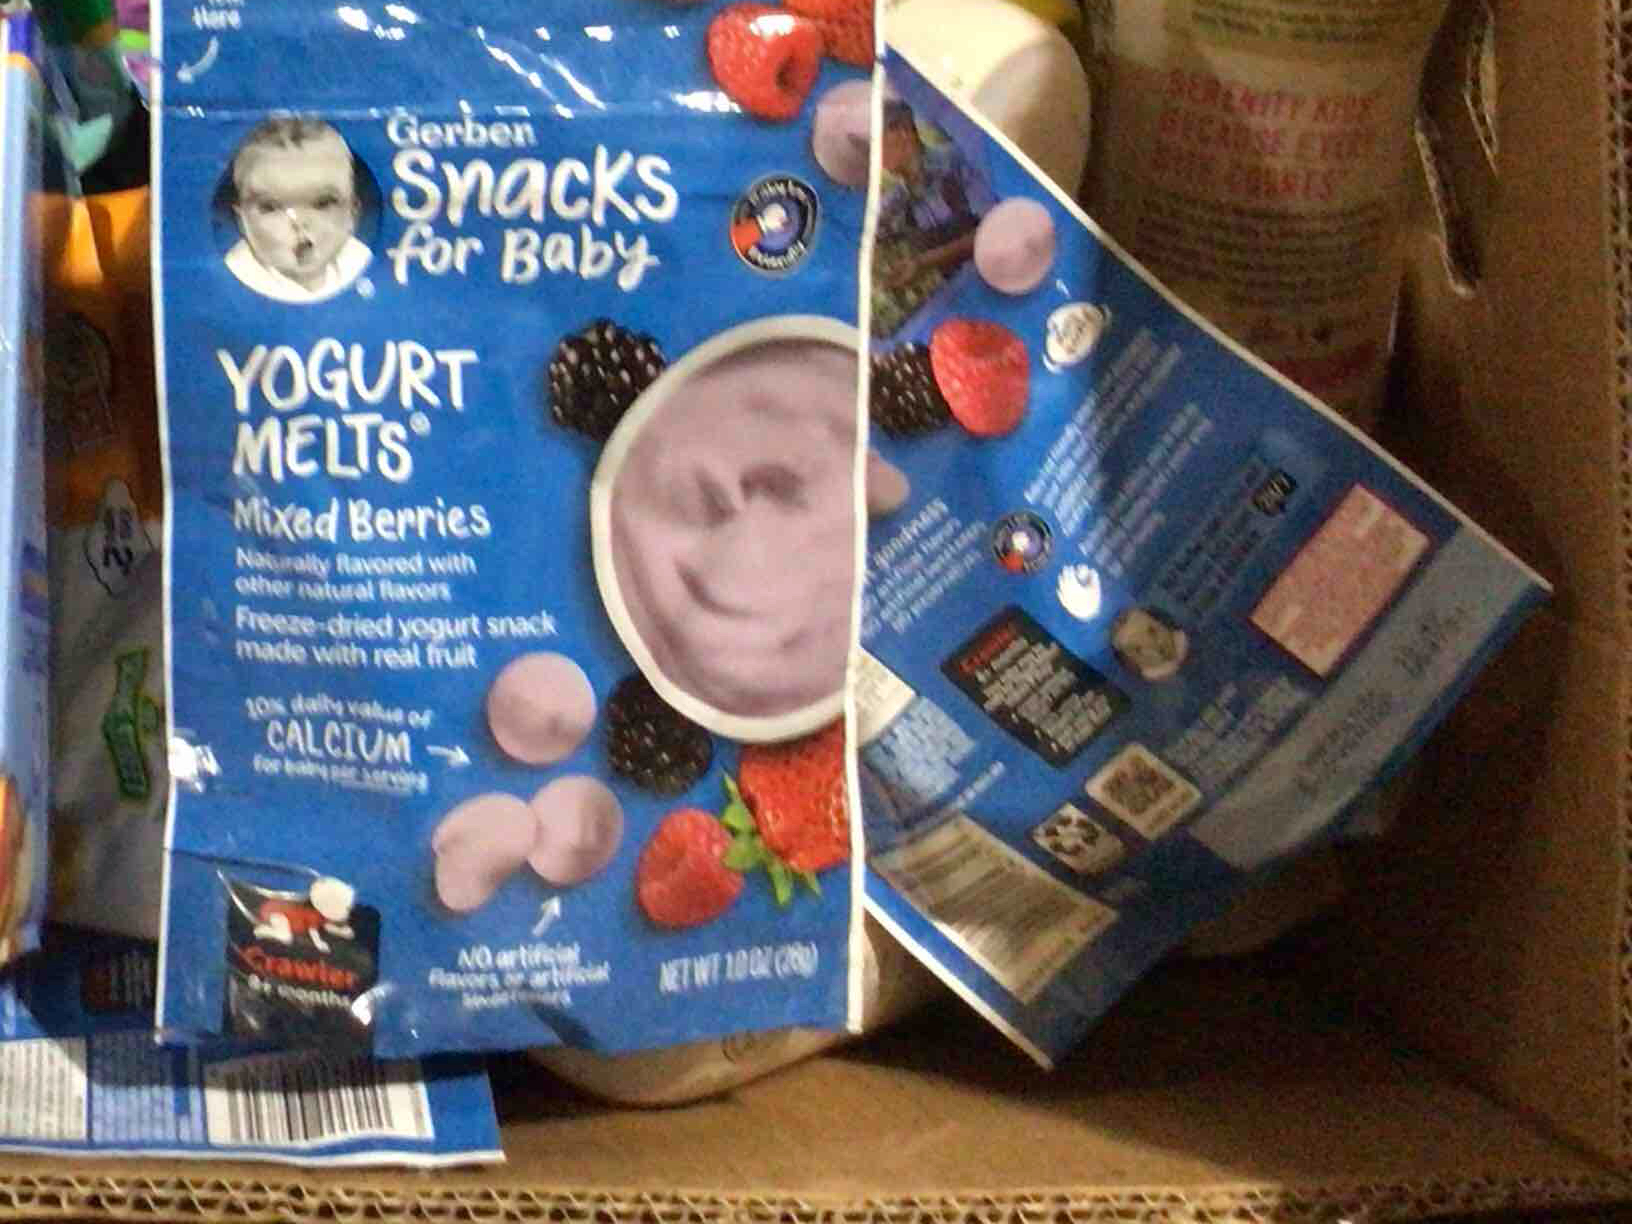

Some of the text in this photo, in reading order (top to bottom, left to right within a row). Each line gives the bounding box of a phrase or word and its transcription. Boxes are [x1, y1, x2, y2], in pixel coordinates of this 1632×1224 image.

[386, 116, 538, 147] Gerber
[389, 145, 680, 224] Snacks
[386, 224, 661, 291] for Baby
[217, 339, 480, 414] YOGURT
[232, 497, 491, 544] Mixed Berries
[235, 547, 478, 580] Naturally flavored with
[235, 576, 451, 602] other natural flavors
[236, 609, 558, 643] Freeze-dried yogurt snack
[236, 638, 478, 669] made with real fruit
[267, 717, 412, 765] CALCIUM
